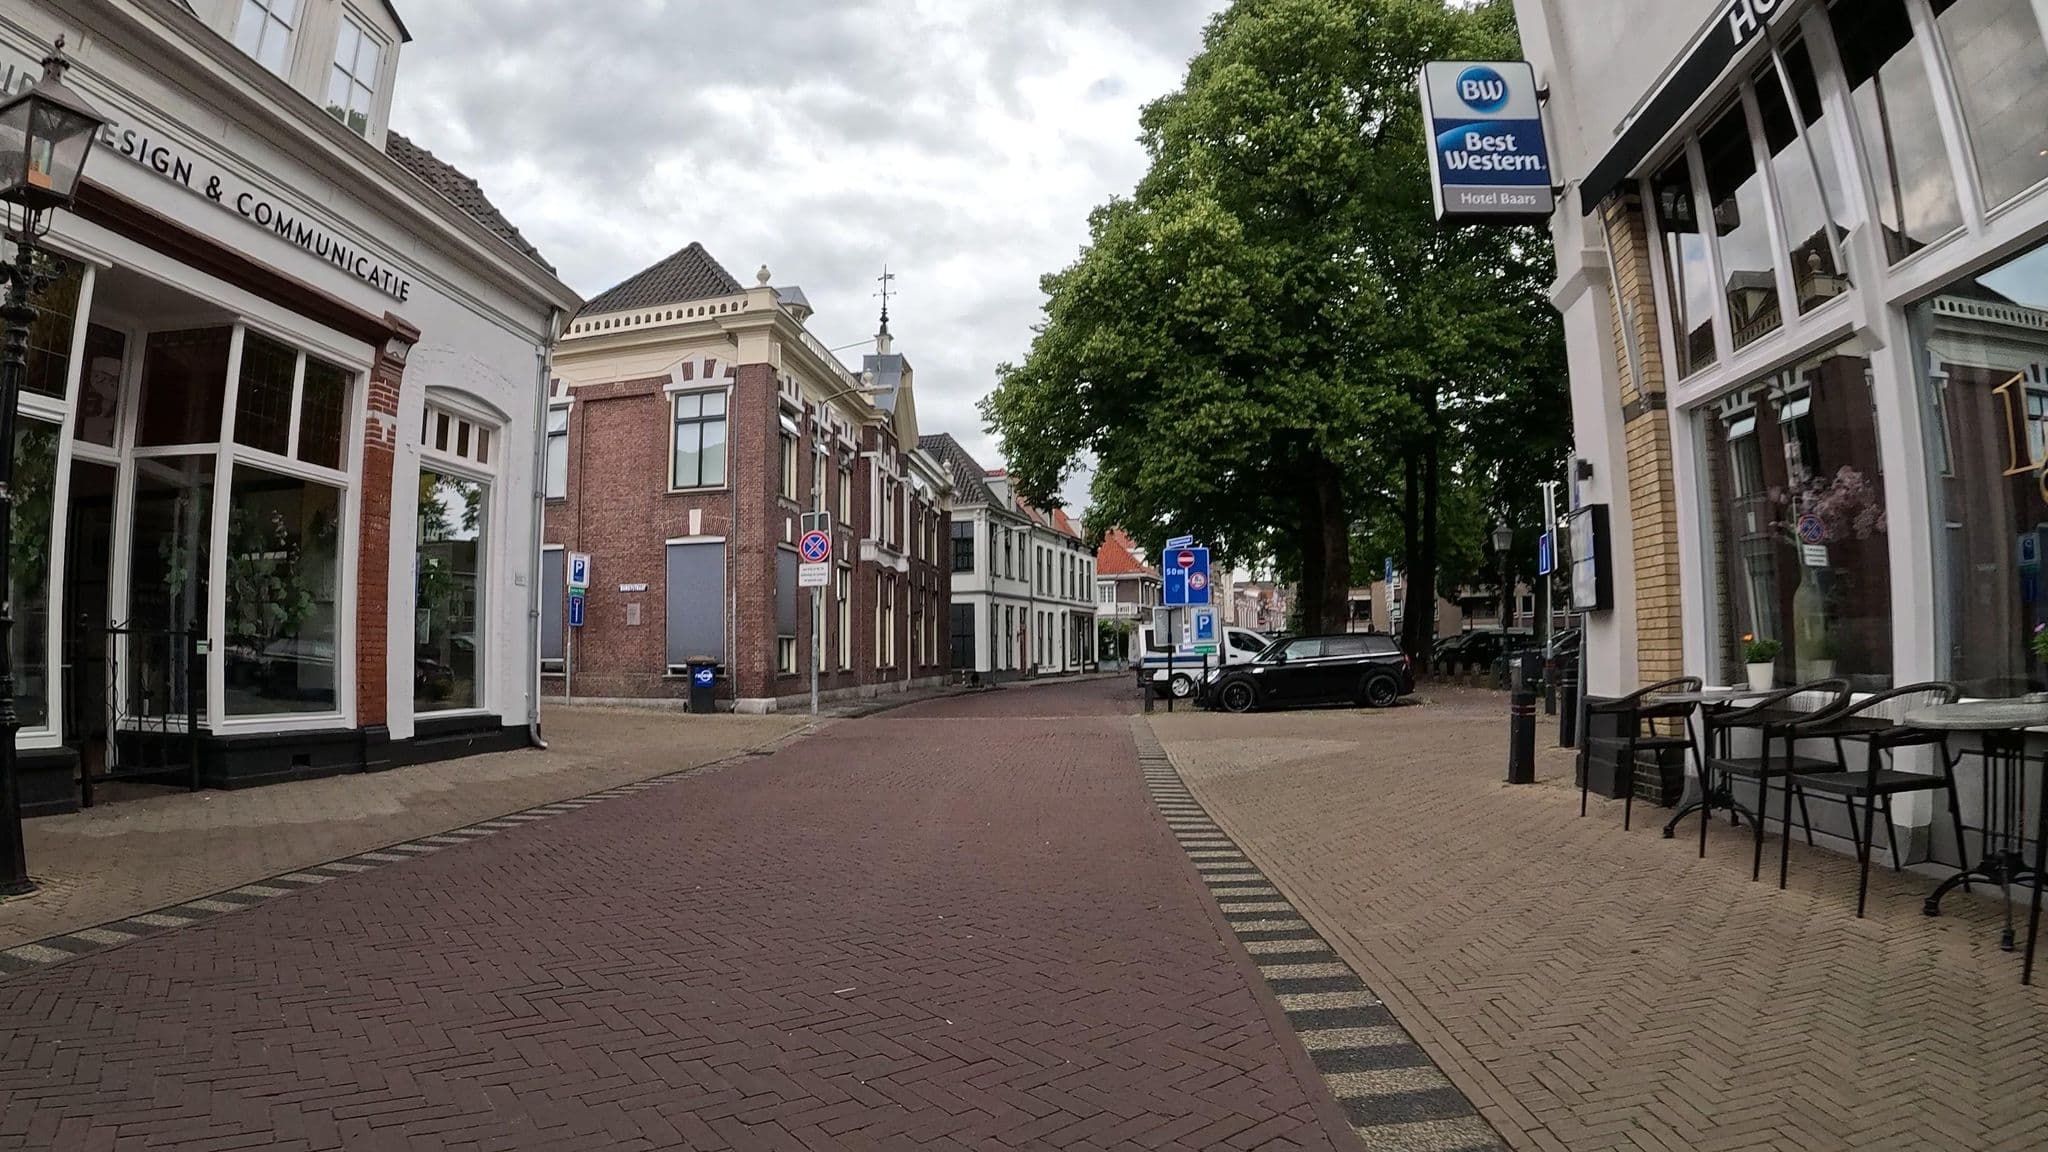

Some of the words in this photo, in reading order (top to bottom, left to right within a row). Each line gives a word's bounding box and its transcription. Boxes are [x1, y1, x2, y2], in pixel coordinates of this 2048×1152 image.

[1462, 80, 1504, 102] BW
[1465, 131, 1517, 152] Best
[1460, 190, 1497, 206] Hotel
[1500, 191, 1537, 206] Baars
[101, 117, 193, 187] ESIGN
[205, 175, 223, 204] &
[236, 192, 411, 302] COMMUNICATIE
